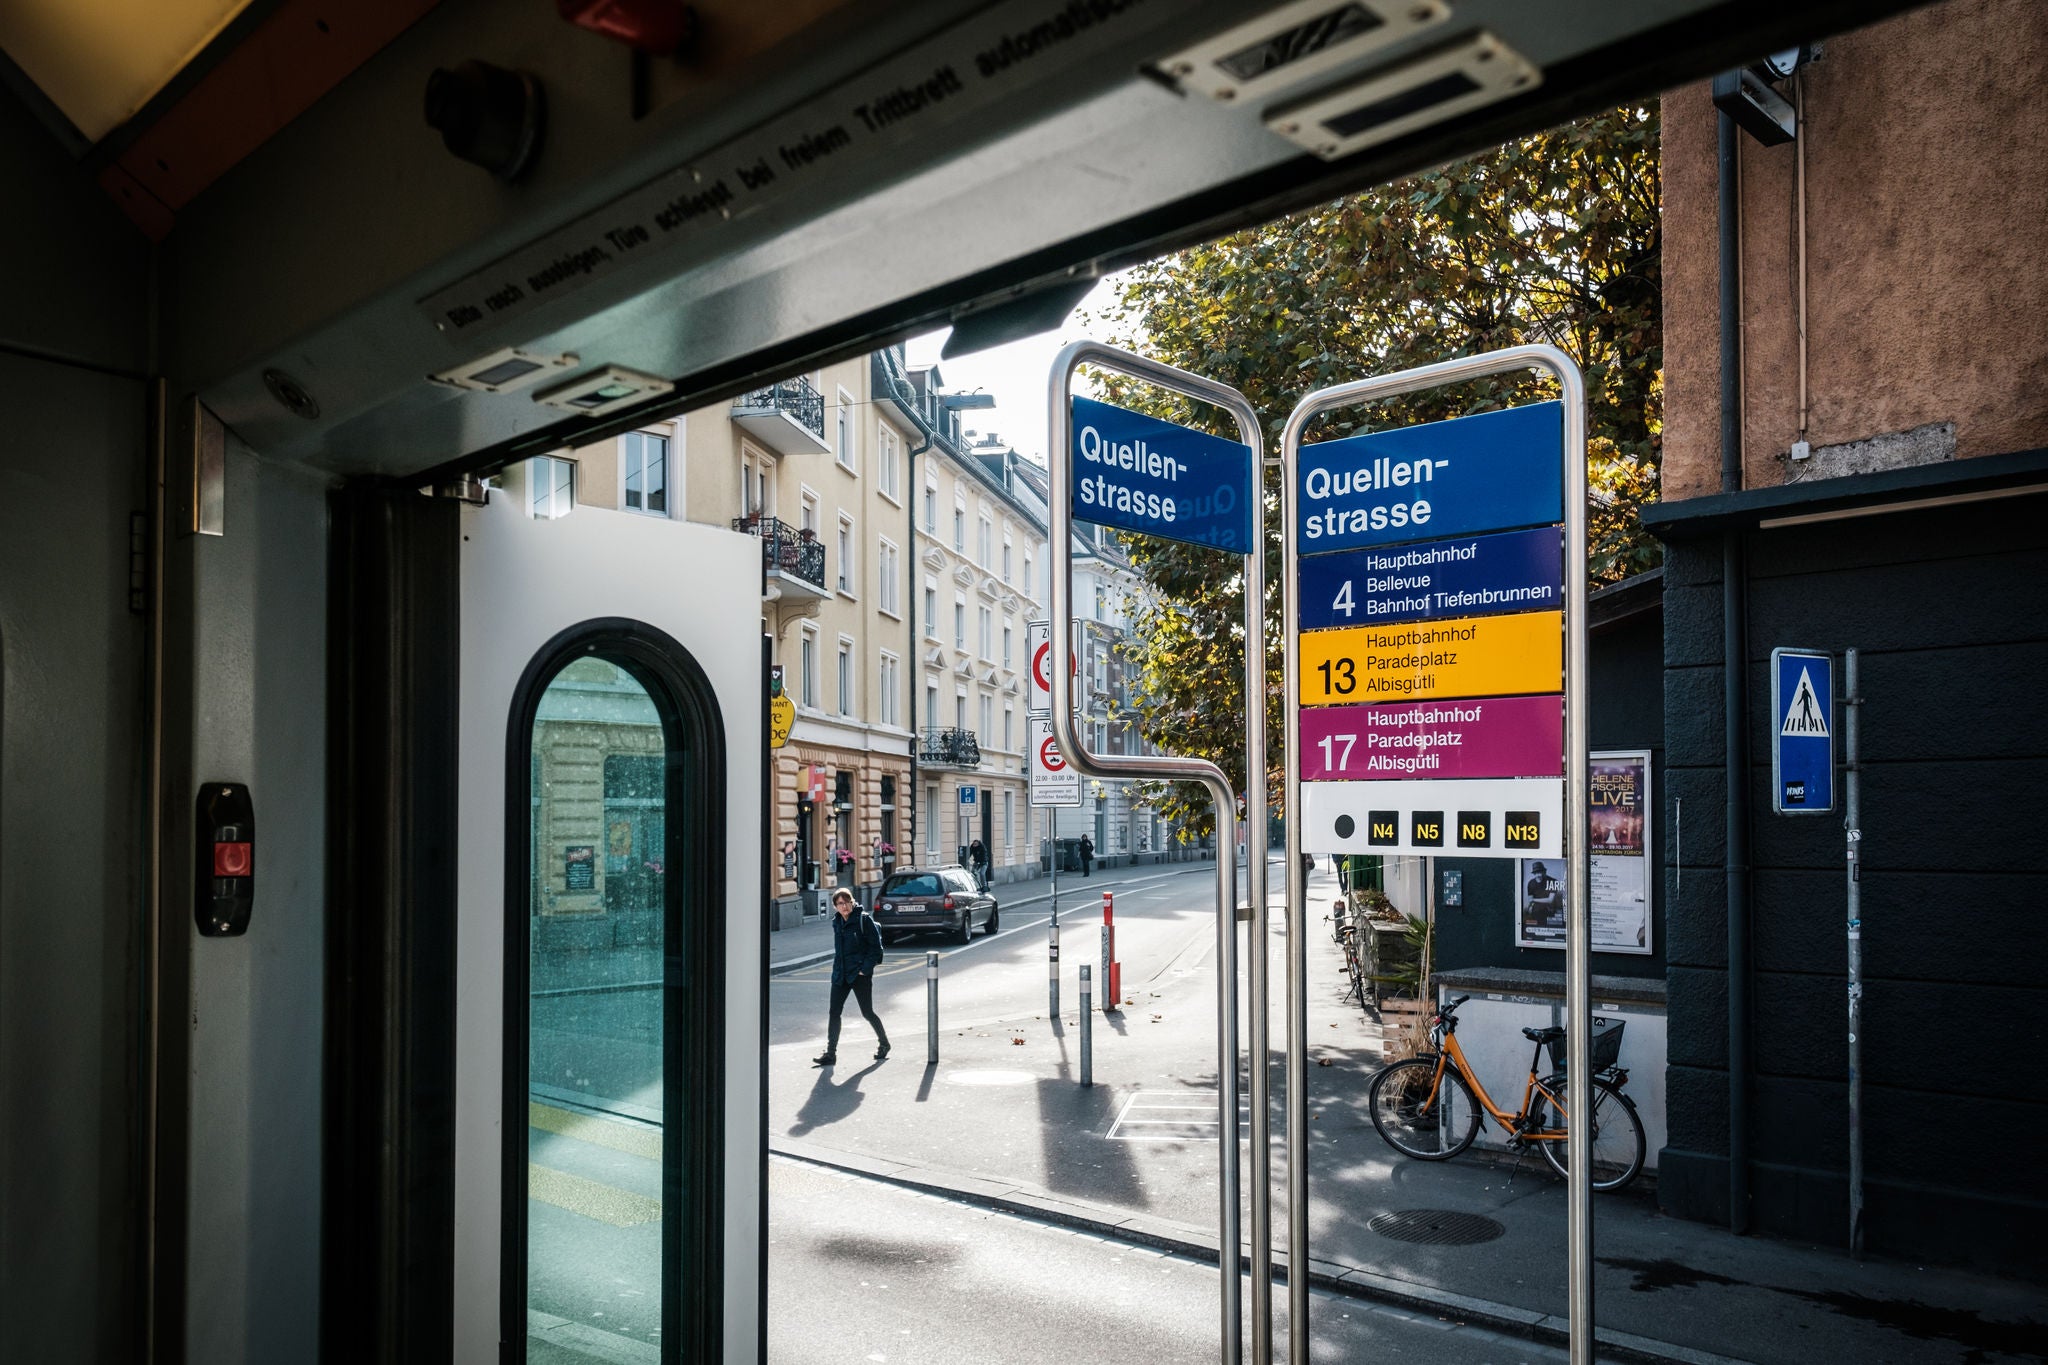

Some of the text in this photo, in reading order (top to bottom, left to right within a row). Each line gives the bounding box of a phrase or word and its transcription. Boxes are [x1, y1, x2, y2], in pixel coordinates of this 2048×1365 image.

[736, 157, 776, 191] bei
[779, 124, 851, 172] freiem
[854, 64, 965, 134] Trittbrett
[1080, 426, 1187, 482] Quellen-
[1306, 457, 1449, 500] Quellen-
[1081, 475, 1176, 522] strasse
[1306, 500, 1432, 539] strasse
[1367, 543, 1477, 572] Hauptbahnhof
[1367, 574, 1431, 593] Bellevue
[1332, 580, 1356, 617] 4
[1367, 584, 1552, 615] Bahnhof Tiefenbrunnen
[1042, 628, 1050, 639] Z
[1367, 625, 1477, 649] Hauptbahnhof
[1367, 651, 1457, 670] Paradeplatz
[1317, 657, 1357, 695] 13
[1366, 674, 1435, 694] Albisgütli
[1367, 706, 1482, 728] Hauptbahnhof
[1367, 731, 1462, 749] Paradeplatz
[1317, 734, 1357, 772] 17
[1367, 754, 1439, 773] Albisgütli
[1590, 783, 1634, 791] FISCHER
[1591, 774, 1634, 783] HELENE
[965, 788, 971, 796] P
[1590, 791, 1635, 805] LIVE
[1373, 823, 1394, 839] N4
[1417, 823, 1439, 840] N5
[1462, 824, 1486, 840] N8
[1507, 825, 1539, 841] N13
[1545, 880, 1566, 891] JARR
